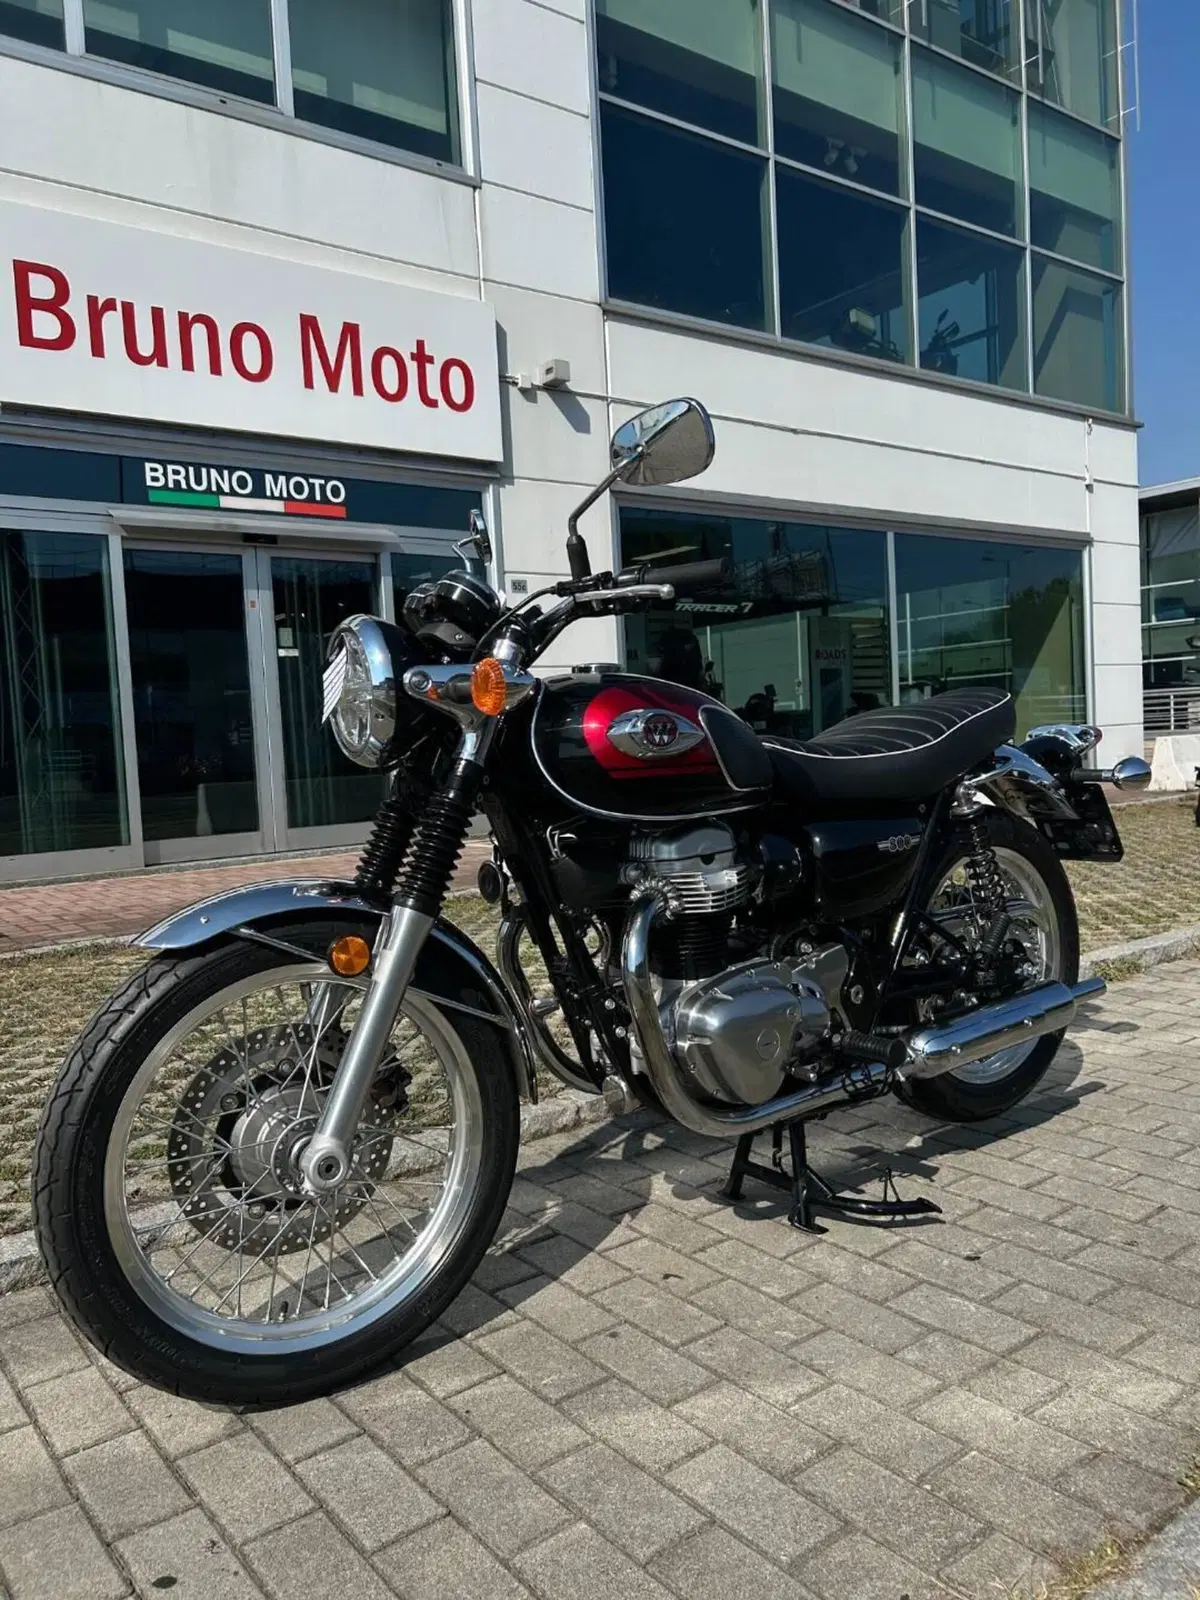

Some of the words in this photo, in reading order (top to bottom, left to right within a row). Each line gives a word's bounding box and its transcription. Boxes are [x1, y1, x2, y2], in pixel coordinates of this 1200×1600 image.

[13, 259, 273, 383] Bruno
[299, 313, 475, 413] Moto
[144, 462, 253, 495] BRUNO
[264, 473, 346, 503] MOTO
[674, 602, 739, 613] TRACER
[740, 601, 754, 613] 7
